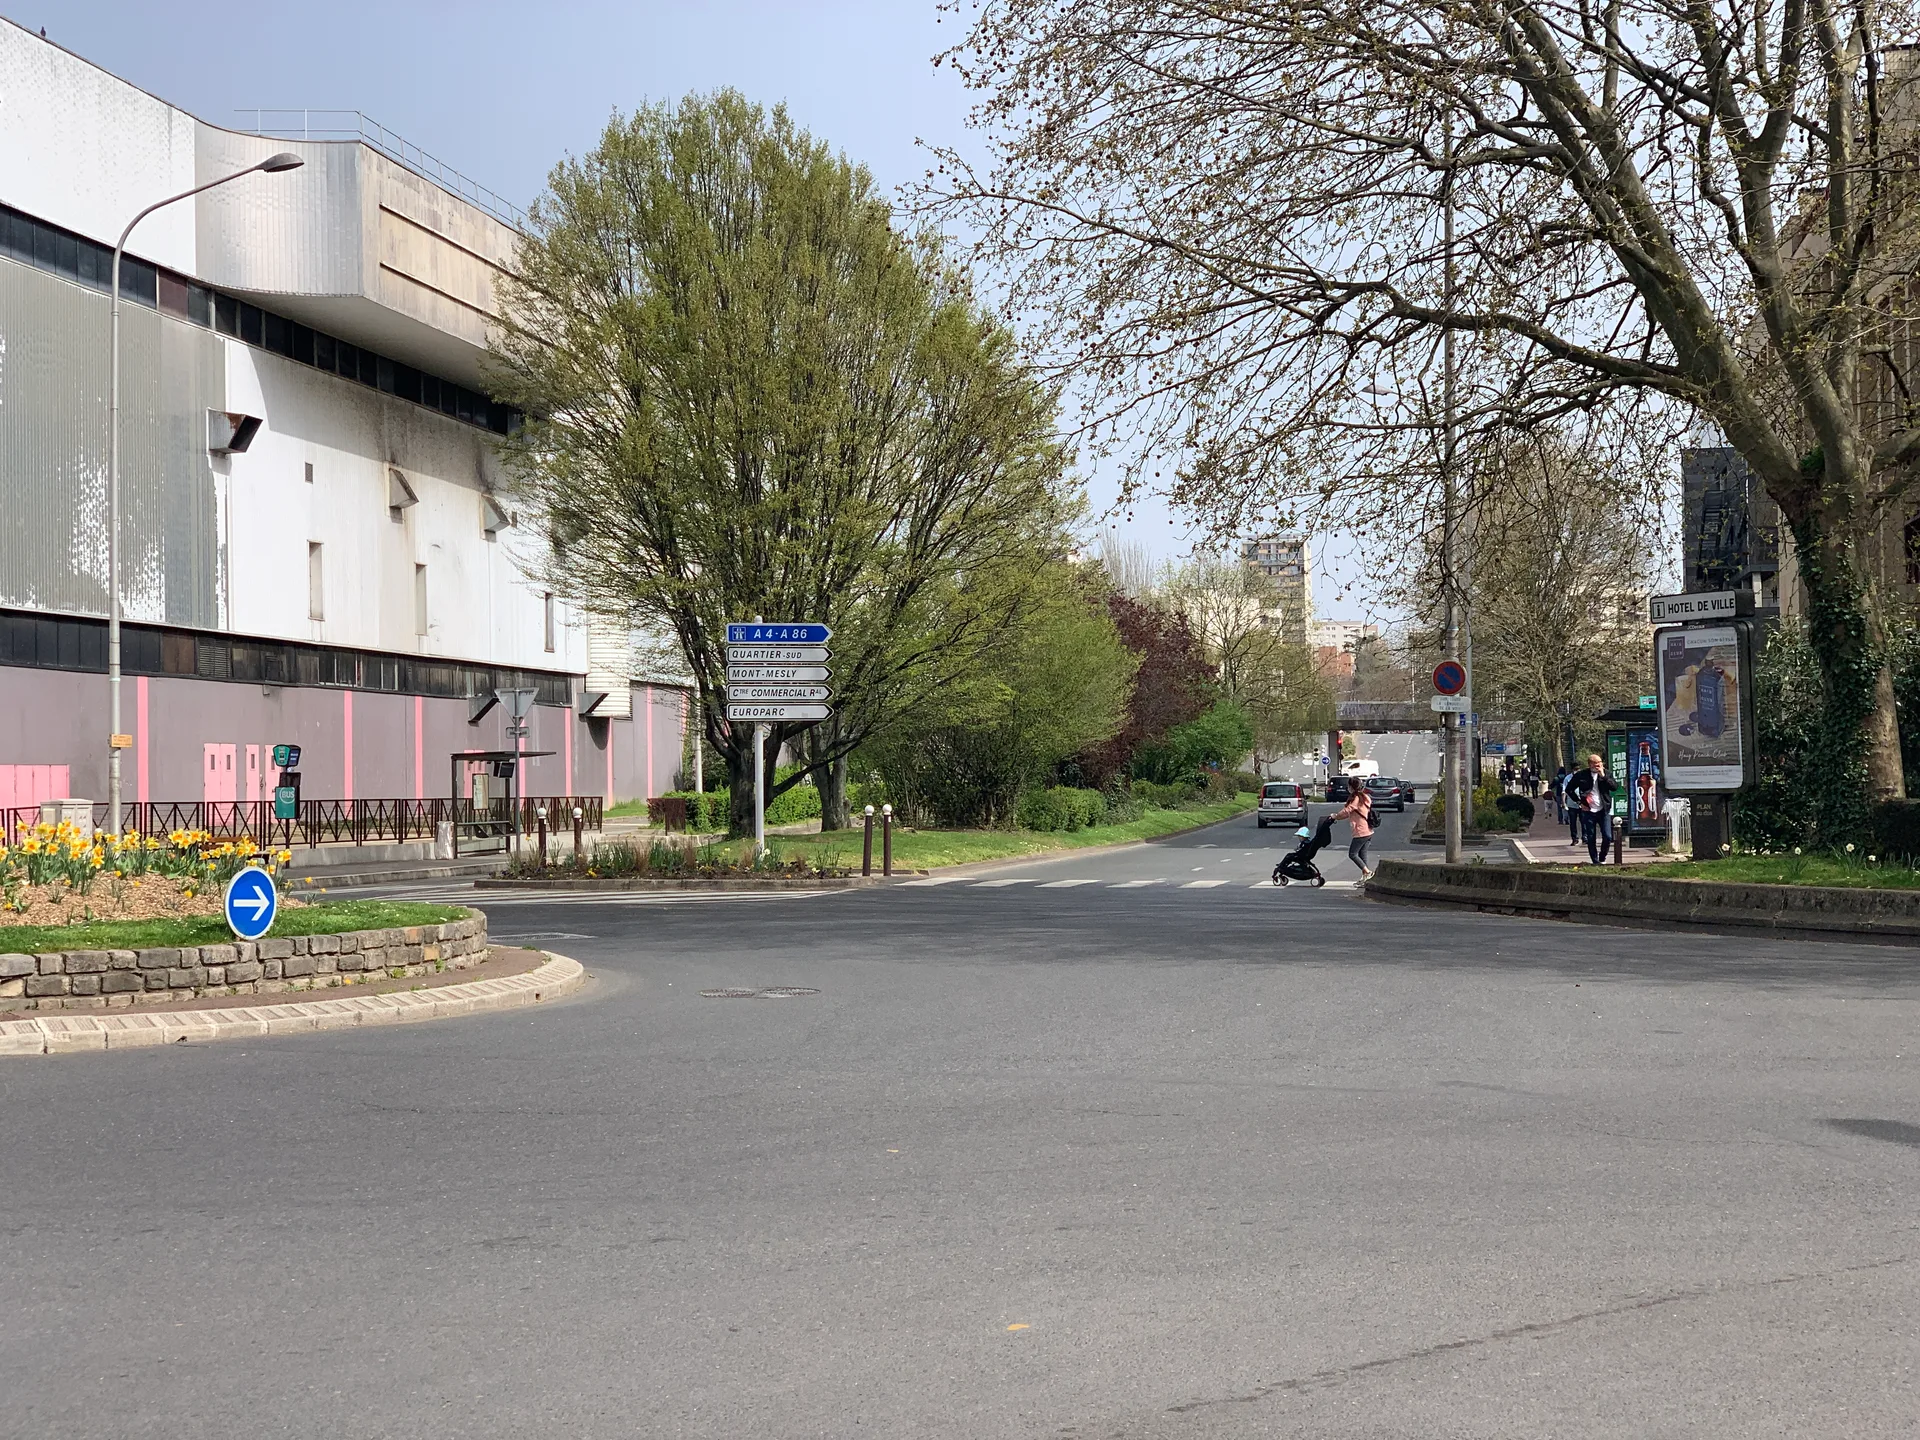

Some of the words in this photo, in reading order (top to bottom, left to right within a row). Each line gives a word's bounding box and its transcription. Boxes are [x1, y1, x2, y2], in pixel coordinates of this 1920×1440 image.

[1668, 602, 1694, 614] HOTEL
[1697, 600, 1708, 611] DE
[1711, 598, 1734, 610] VILLE
[732, 670, 797, 678] MONT-MESLY
[751, 689, 806, 697] COMMERCIAL
[732, 708, 785, 716] EUROPARC
